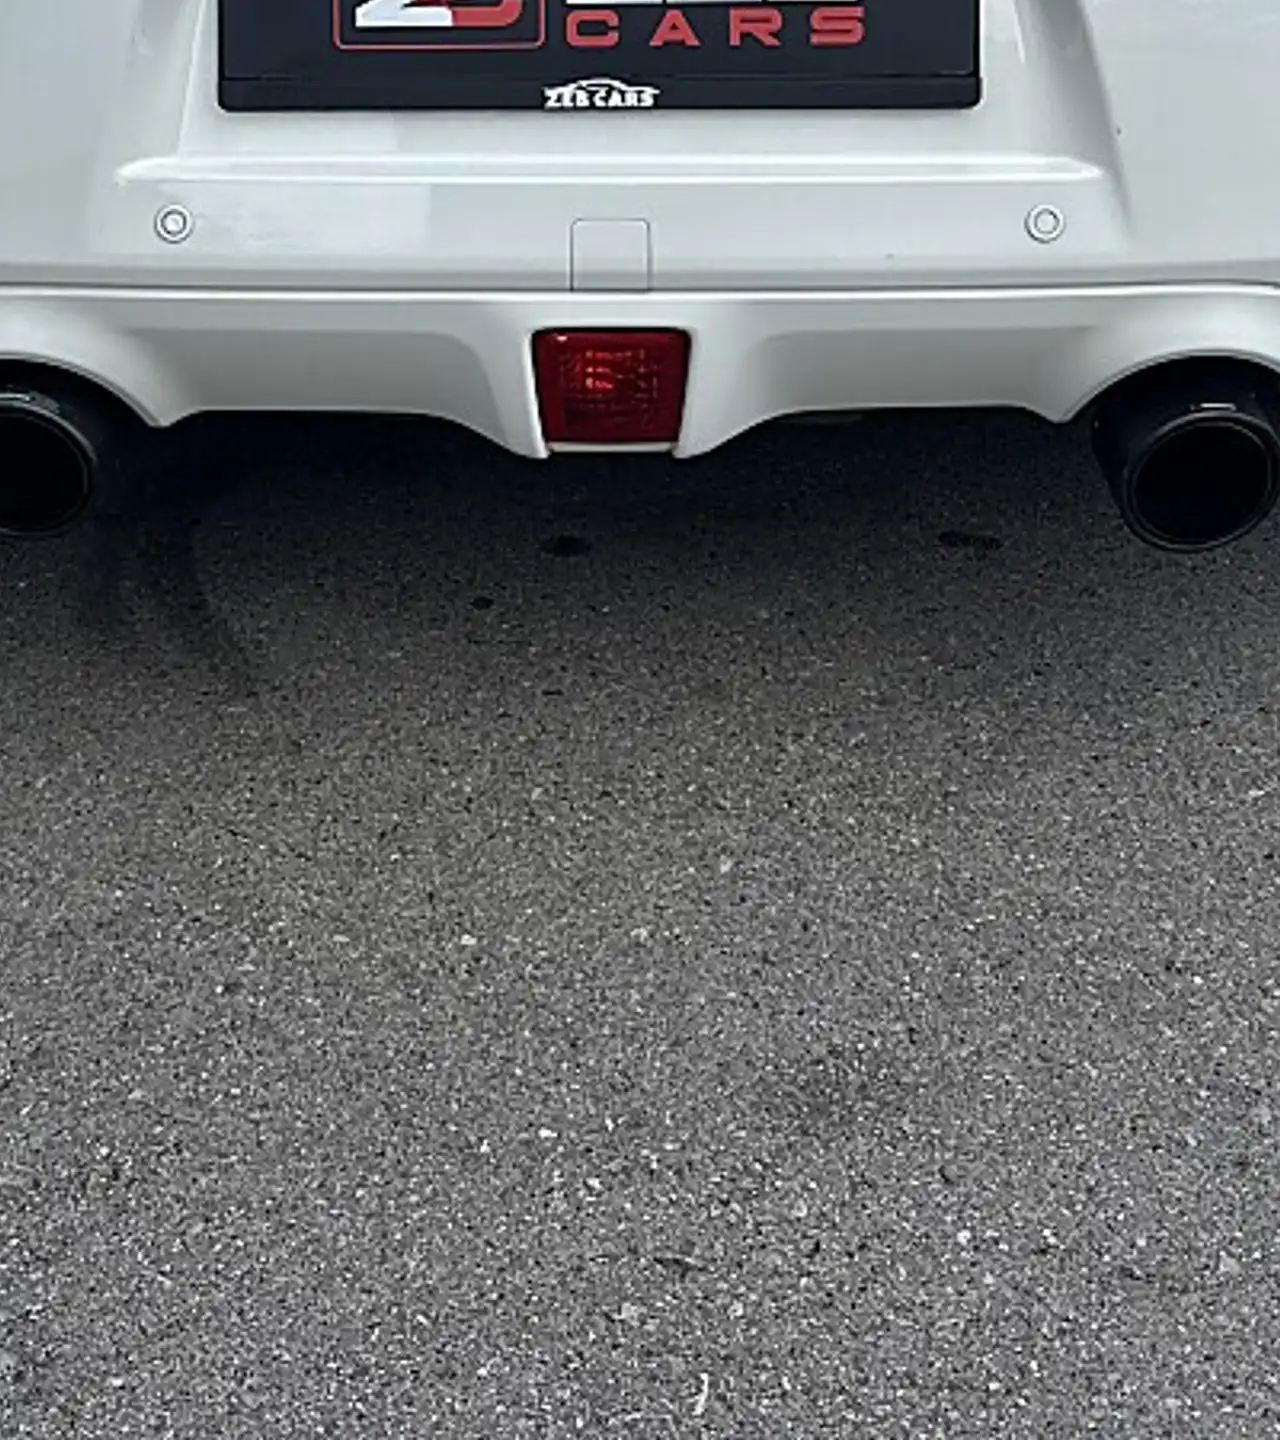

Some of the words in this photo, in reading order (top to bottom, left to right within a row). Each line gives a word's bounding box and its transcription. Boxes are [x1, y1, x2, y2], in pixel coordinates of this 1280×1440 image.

[565, 6, 865, 47] CARS
[542, 87, 590, 107] ZEB
[592, 87, 655, 107] CARS
